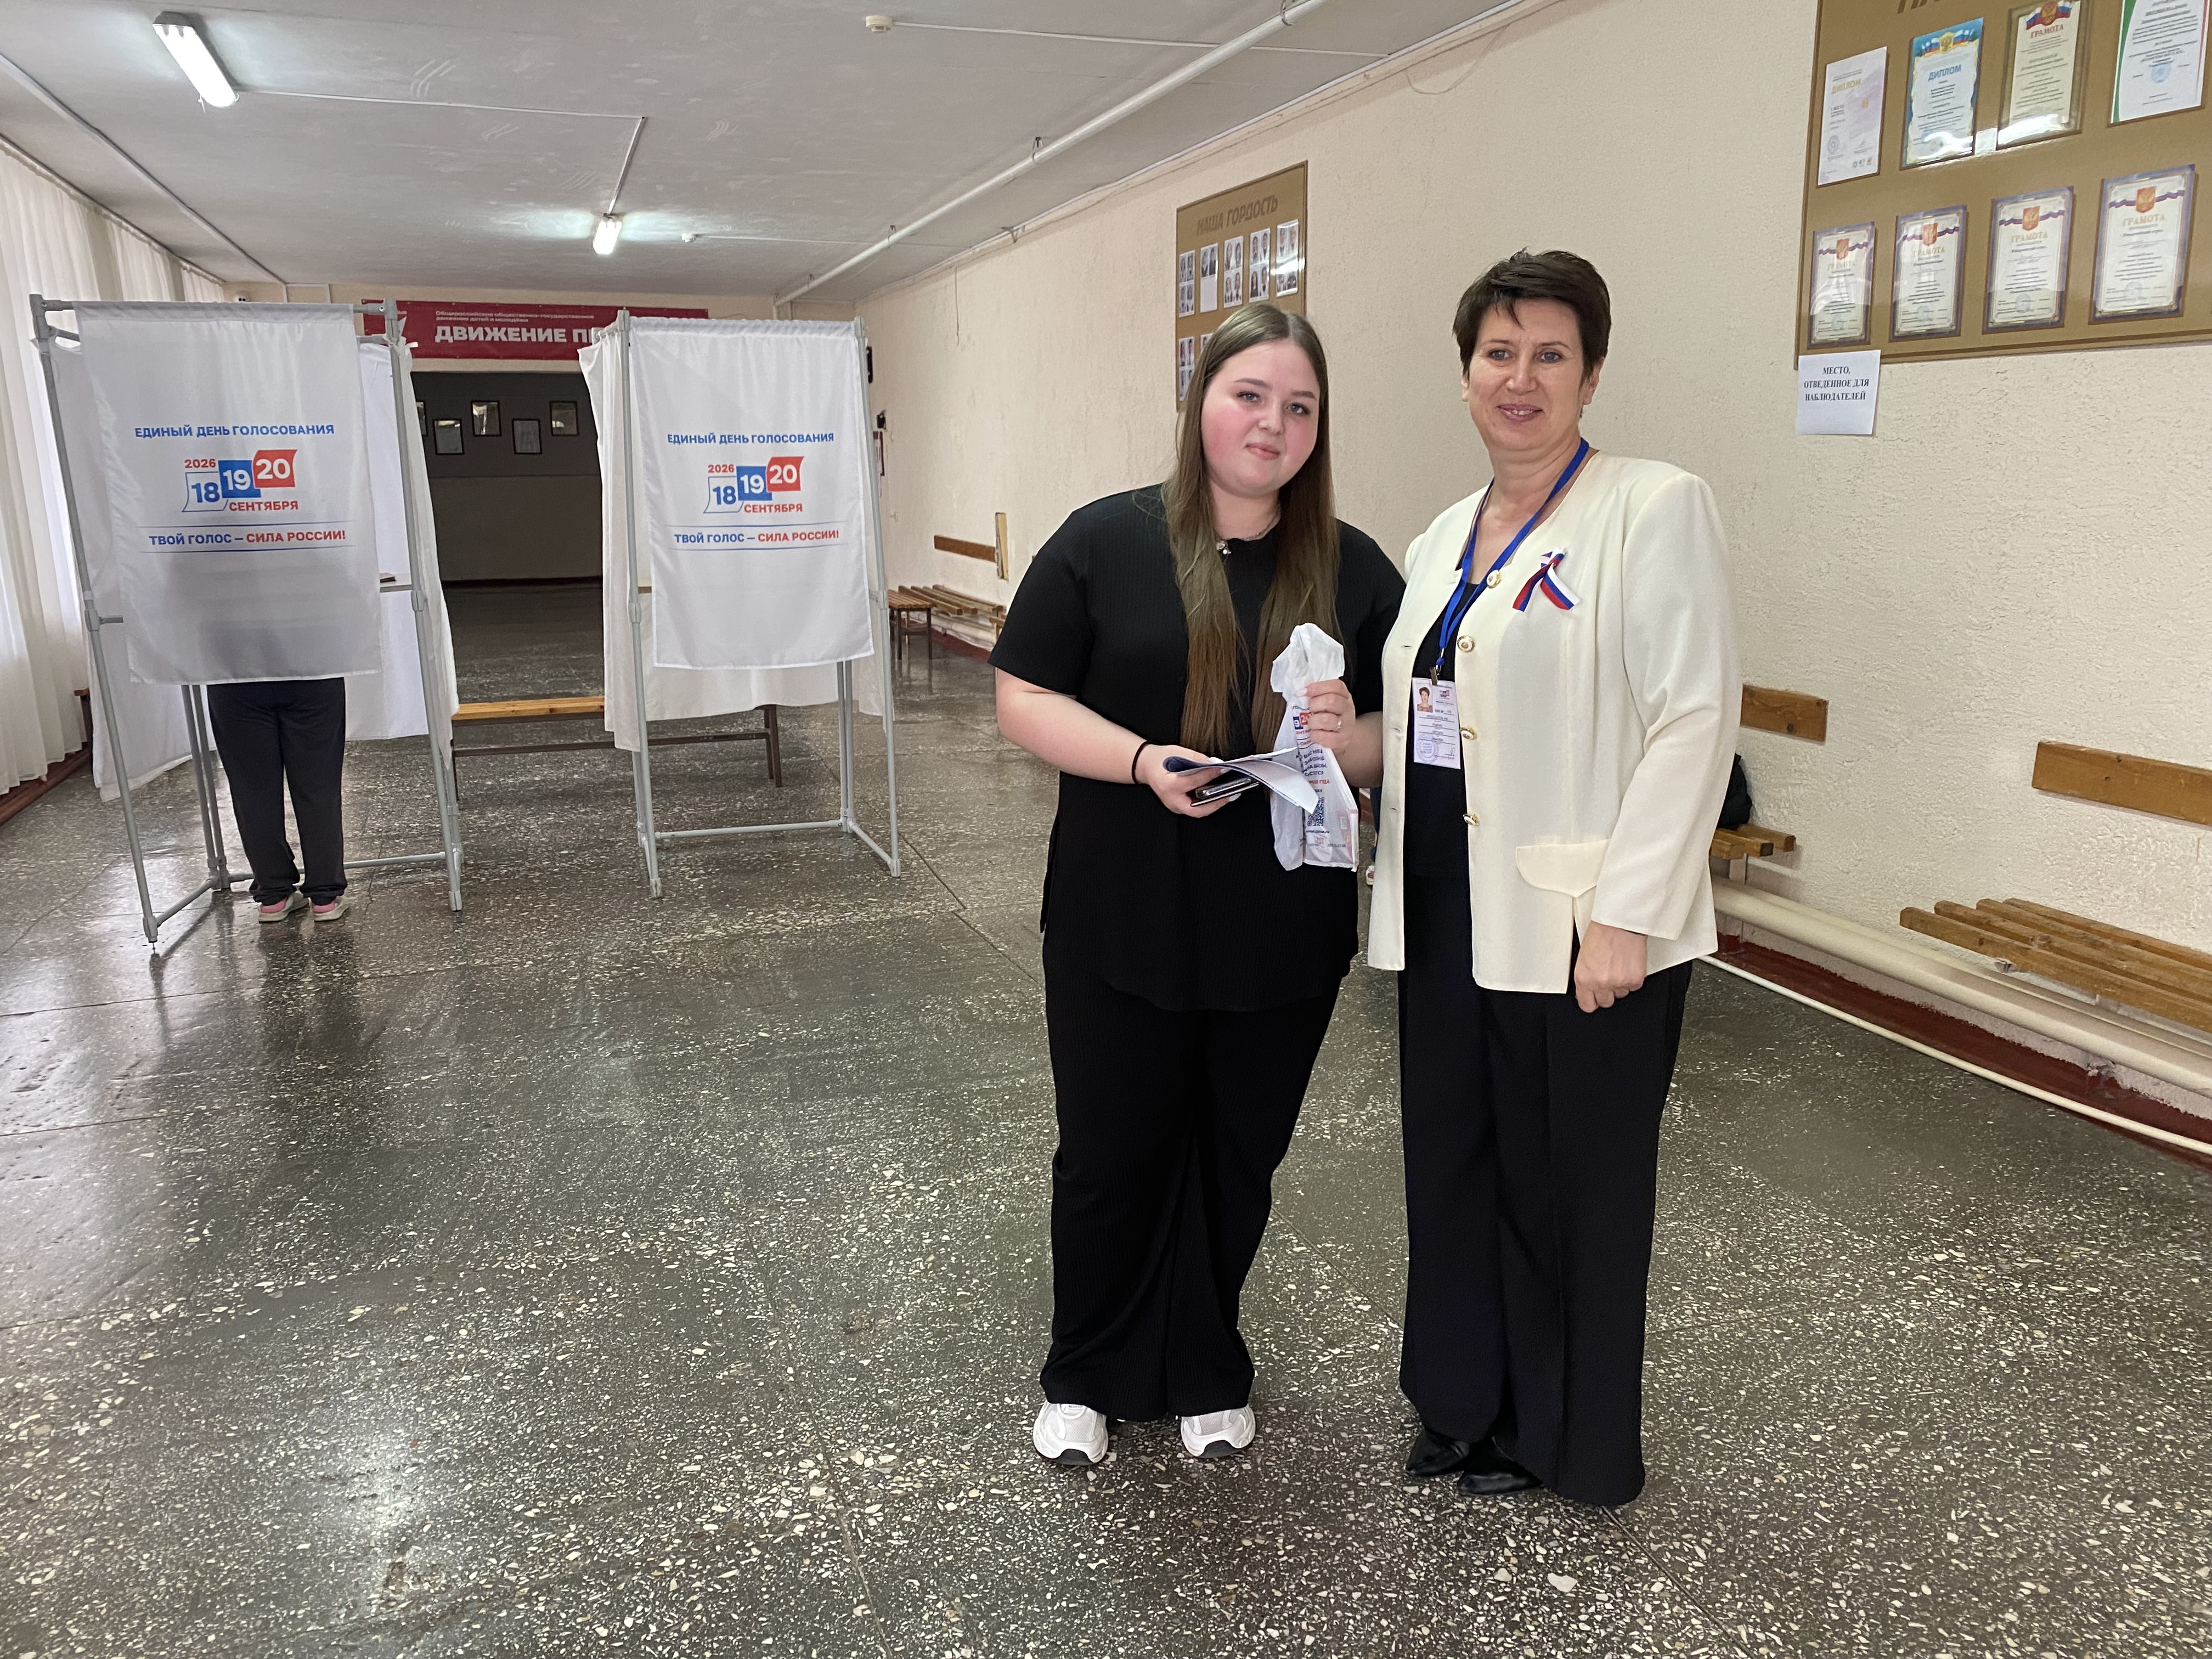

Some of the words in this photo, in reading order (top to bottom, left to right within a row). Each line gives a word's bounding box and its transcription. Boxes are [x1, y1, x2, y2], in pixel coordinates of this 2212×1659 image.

[2030, 24, 2064, 38] ГРАМОТА
[1928, 64, 1961, 82] ДИПЛОМ
[1831, 78, 1861, 94] ДИПЛОМ
[1197, 212, 1223, 235] НАША
[1226, 195, 1278, 228] ГОРДОСТЬ
[2123, 213, 2165, 227] ГРАМОТА
[2011, 231, 2047, 243] ГРАМОТА
[435, 326, 567, 343] ДВИЖЕНИЕ
[1822, 366, 1850, 375] МЕСТО,
[1804, 379, 1852, 388] ОТВЕДЕННОЕ
[1852, 379, 1869, 388] ДЛЯ
[1805, 391, 1866, 401] НАБЛЮДАТЕЛЕЙ
[135, 425, 193, 438] ЕДИНЫЙ
[196, 426, 230, 437] ДЕНЬ
[233, 424, 335, 436] ГОЛОСОВАНИЯ
[668, 432, 716, 445] ЕДИНЫЙ
[719, 434, 749, 444] ДЕНЬ
[752, 432, 834, 444] ГОЛОСОВАНИЯ
[184, 459, 216, 469] 2026
[708, 464, 735, 473] 2026
[191, 482, 220, 503] 18
[223, 469, 251, 490] 19
[256, 458, 290, 479] 20
[713, 486, 736, 505] 18
[741, 474, 764, 494] 19
[769, 465, 797, 484] 20
[229, 501, 298, 511] СЕНТЯБРЯ
[744, 503, 803, 513] СЕНТЯБРЯ
[149, 533, 184, 545] ТВОЙ
[188, 534, 232, 544] ГОЛОС
[246, 532, 284, 543] СИЛА
[287, 530, 346, 541] РОССИИ!
[674, 532, 704, 543] ТВОЙ
[707, 533, 744, 543] ГОЛОС
[758, 532, 789, 542] СИЛА
[792, 530, 839, 541] РОССИИ!
